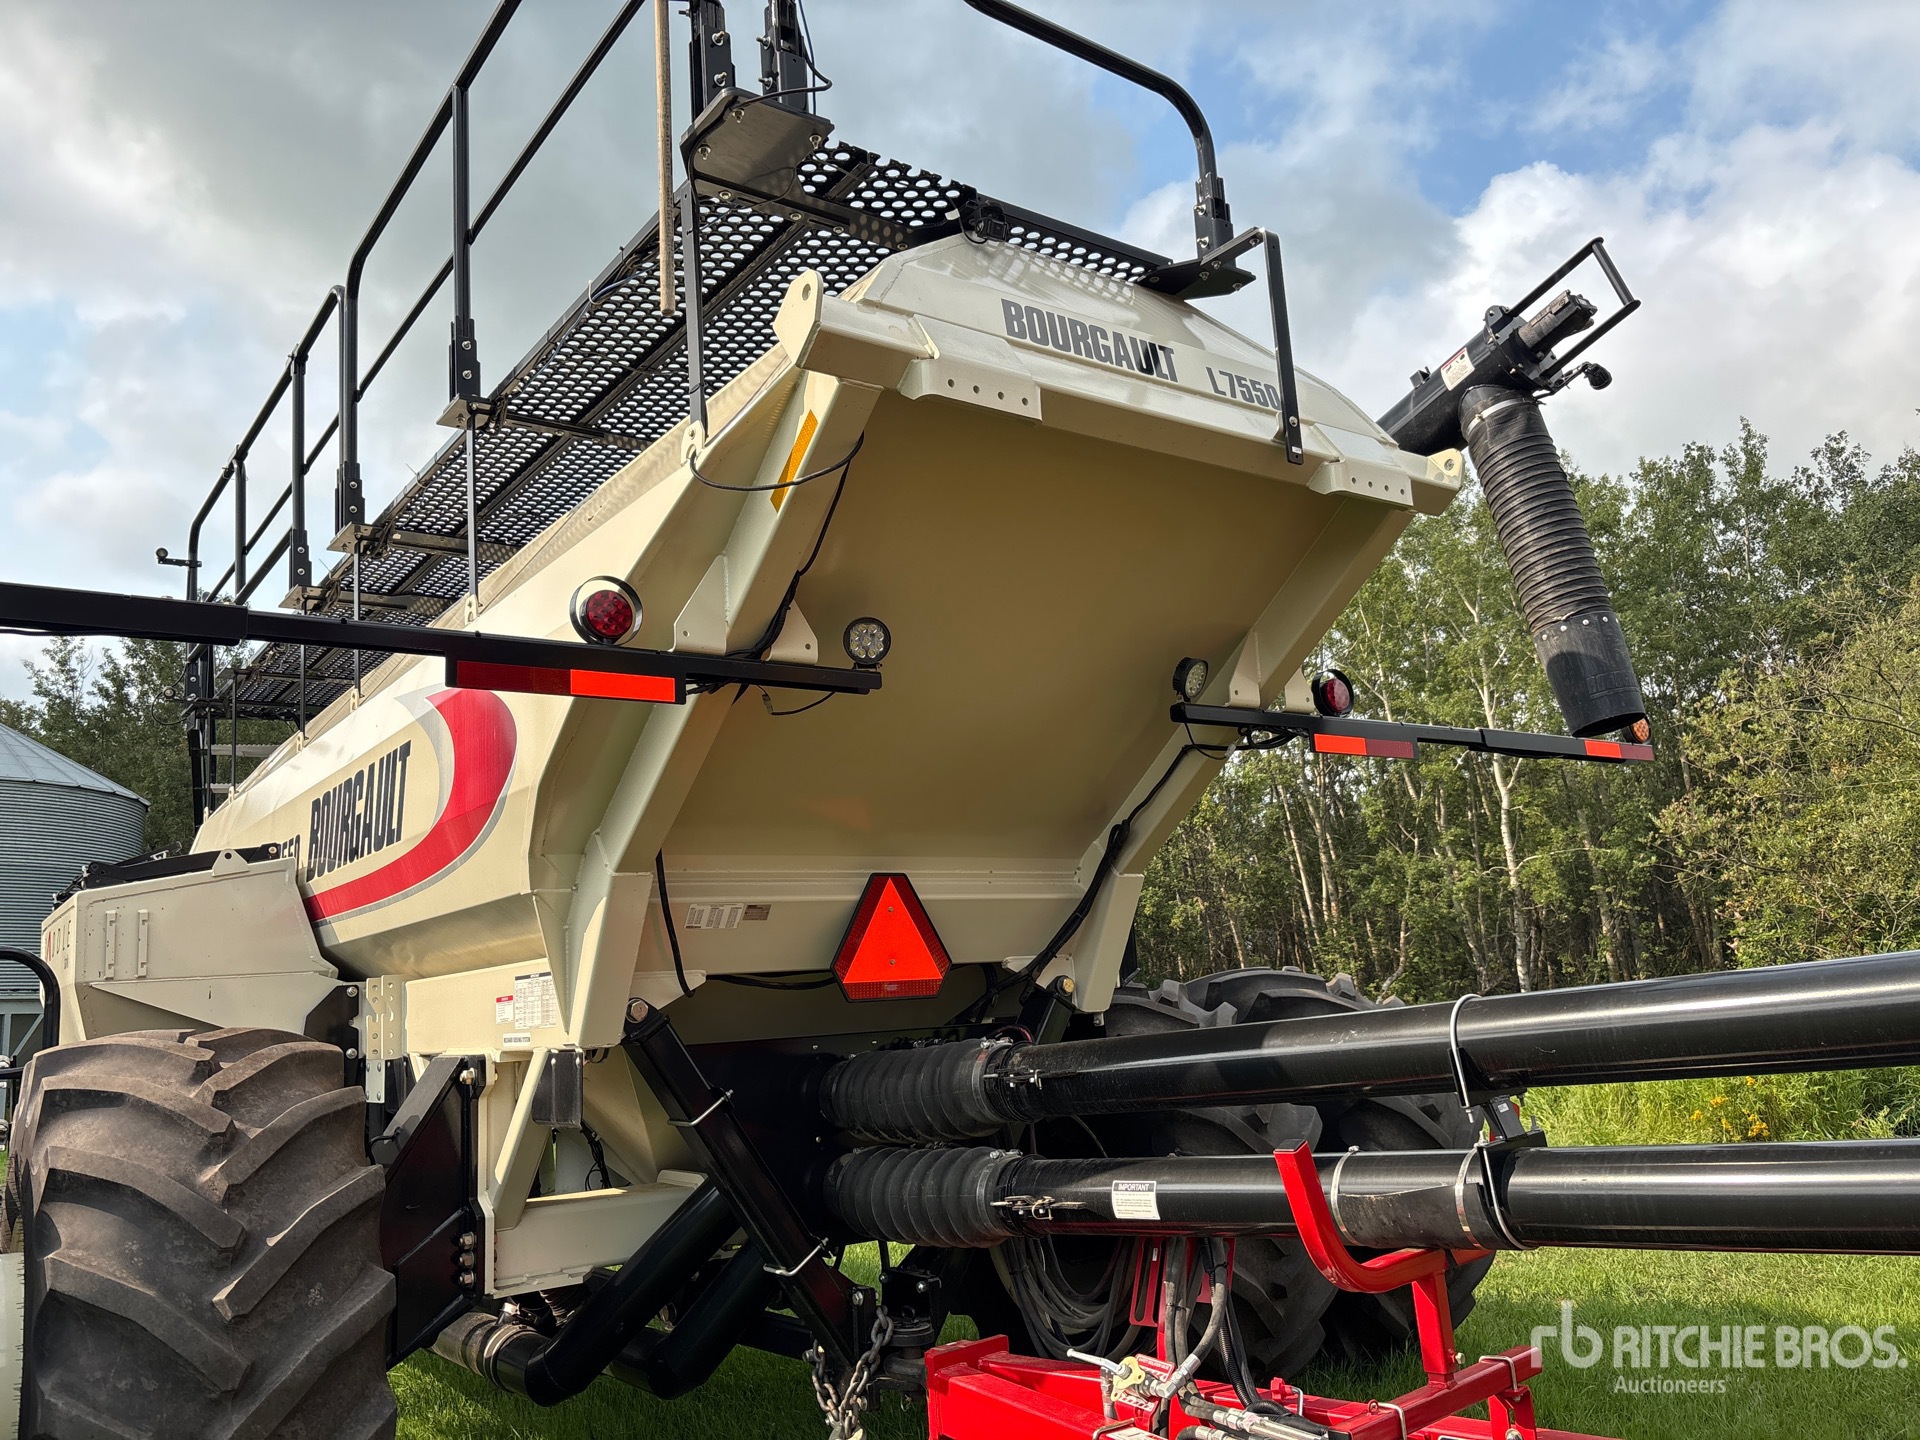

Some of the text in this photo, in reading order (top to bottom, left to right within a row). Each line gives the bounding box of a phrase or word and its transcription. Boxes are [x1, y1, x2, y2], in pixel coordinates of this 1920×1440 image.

[1001, 298, 1281, 411] BOURGAULT L7550
[307, 740, 411, 882] BOURGAULT
[1118, 1183, 1150, 1192] IMPORTANT
